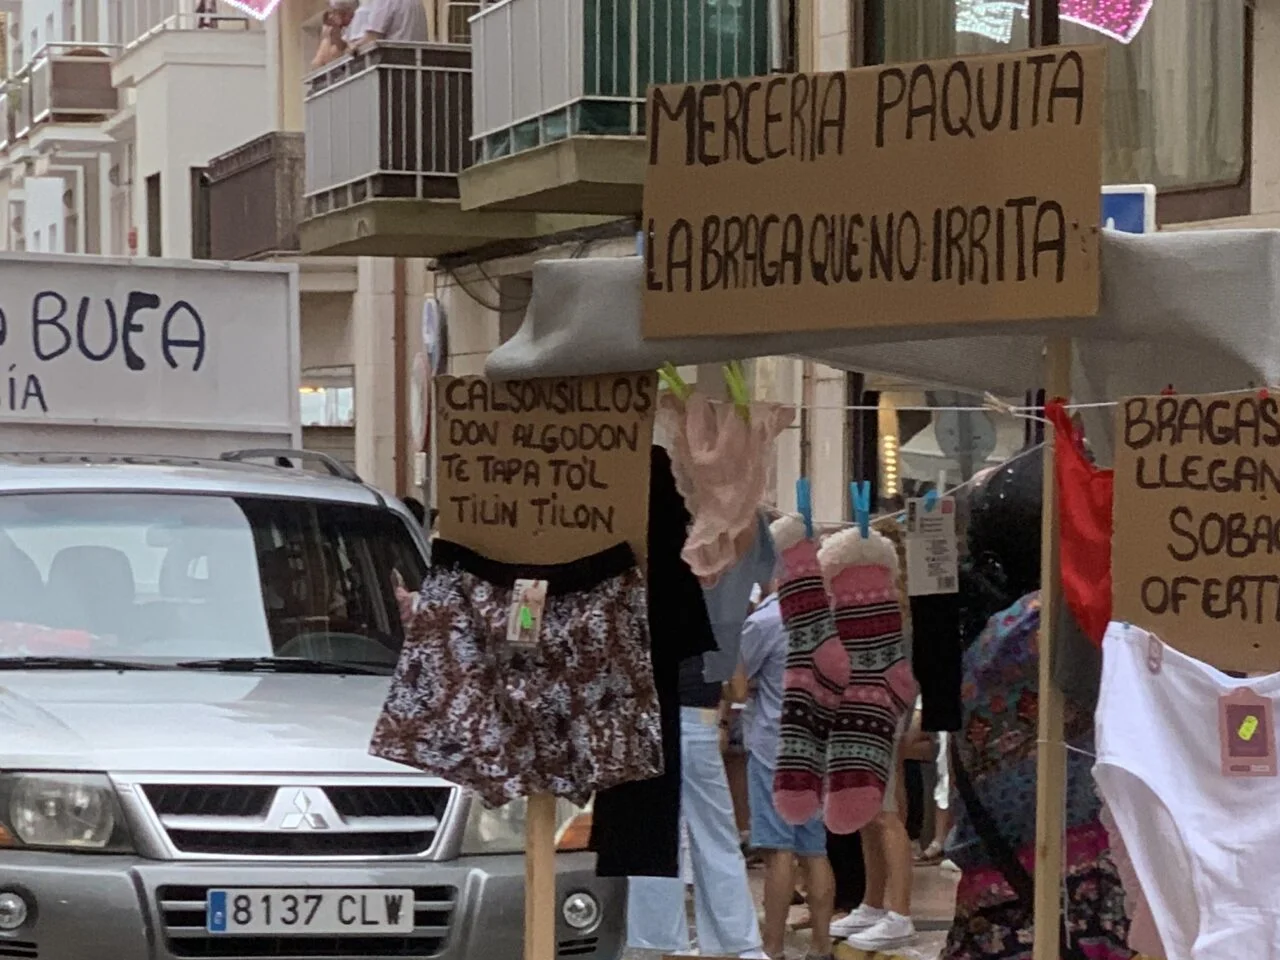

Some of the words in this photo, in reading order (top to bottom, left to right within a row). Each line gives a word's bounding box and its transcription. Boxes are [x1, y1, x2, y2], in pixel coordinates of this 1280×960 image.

[649, 72, 847, 166] MERCERIA
[875, 51, 1084, 148] PAQUITA
[646, 218, 693, 292] LA
[700, 213, 803, 291] BRAGA
[808, 213, 864, 286] QUE
[869, 210, 921, 281] NO
[931, 196, 1066, 285] IRRITA
[0, 363, 48, 413] ÍA
[441, 453, 470, 482] TE
[477, 455, 541, 487] TAPA
[232, 894, 323, 926] 8137
[337, 894, 403, 926] CLW
